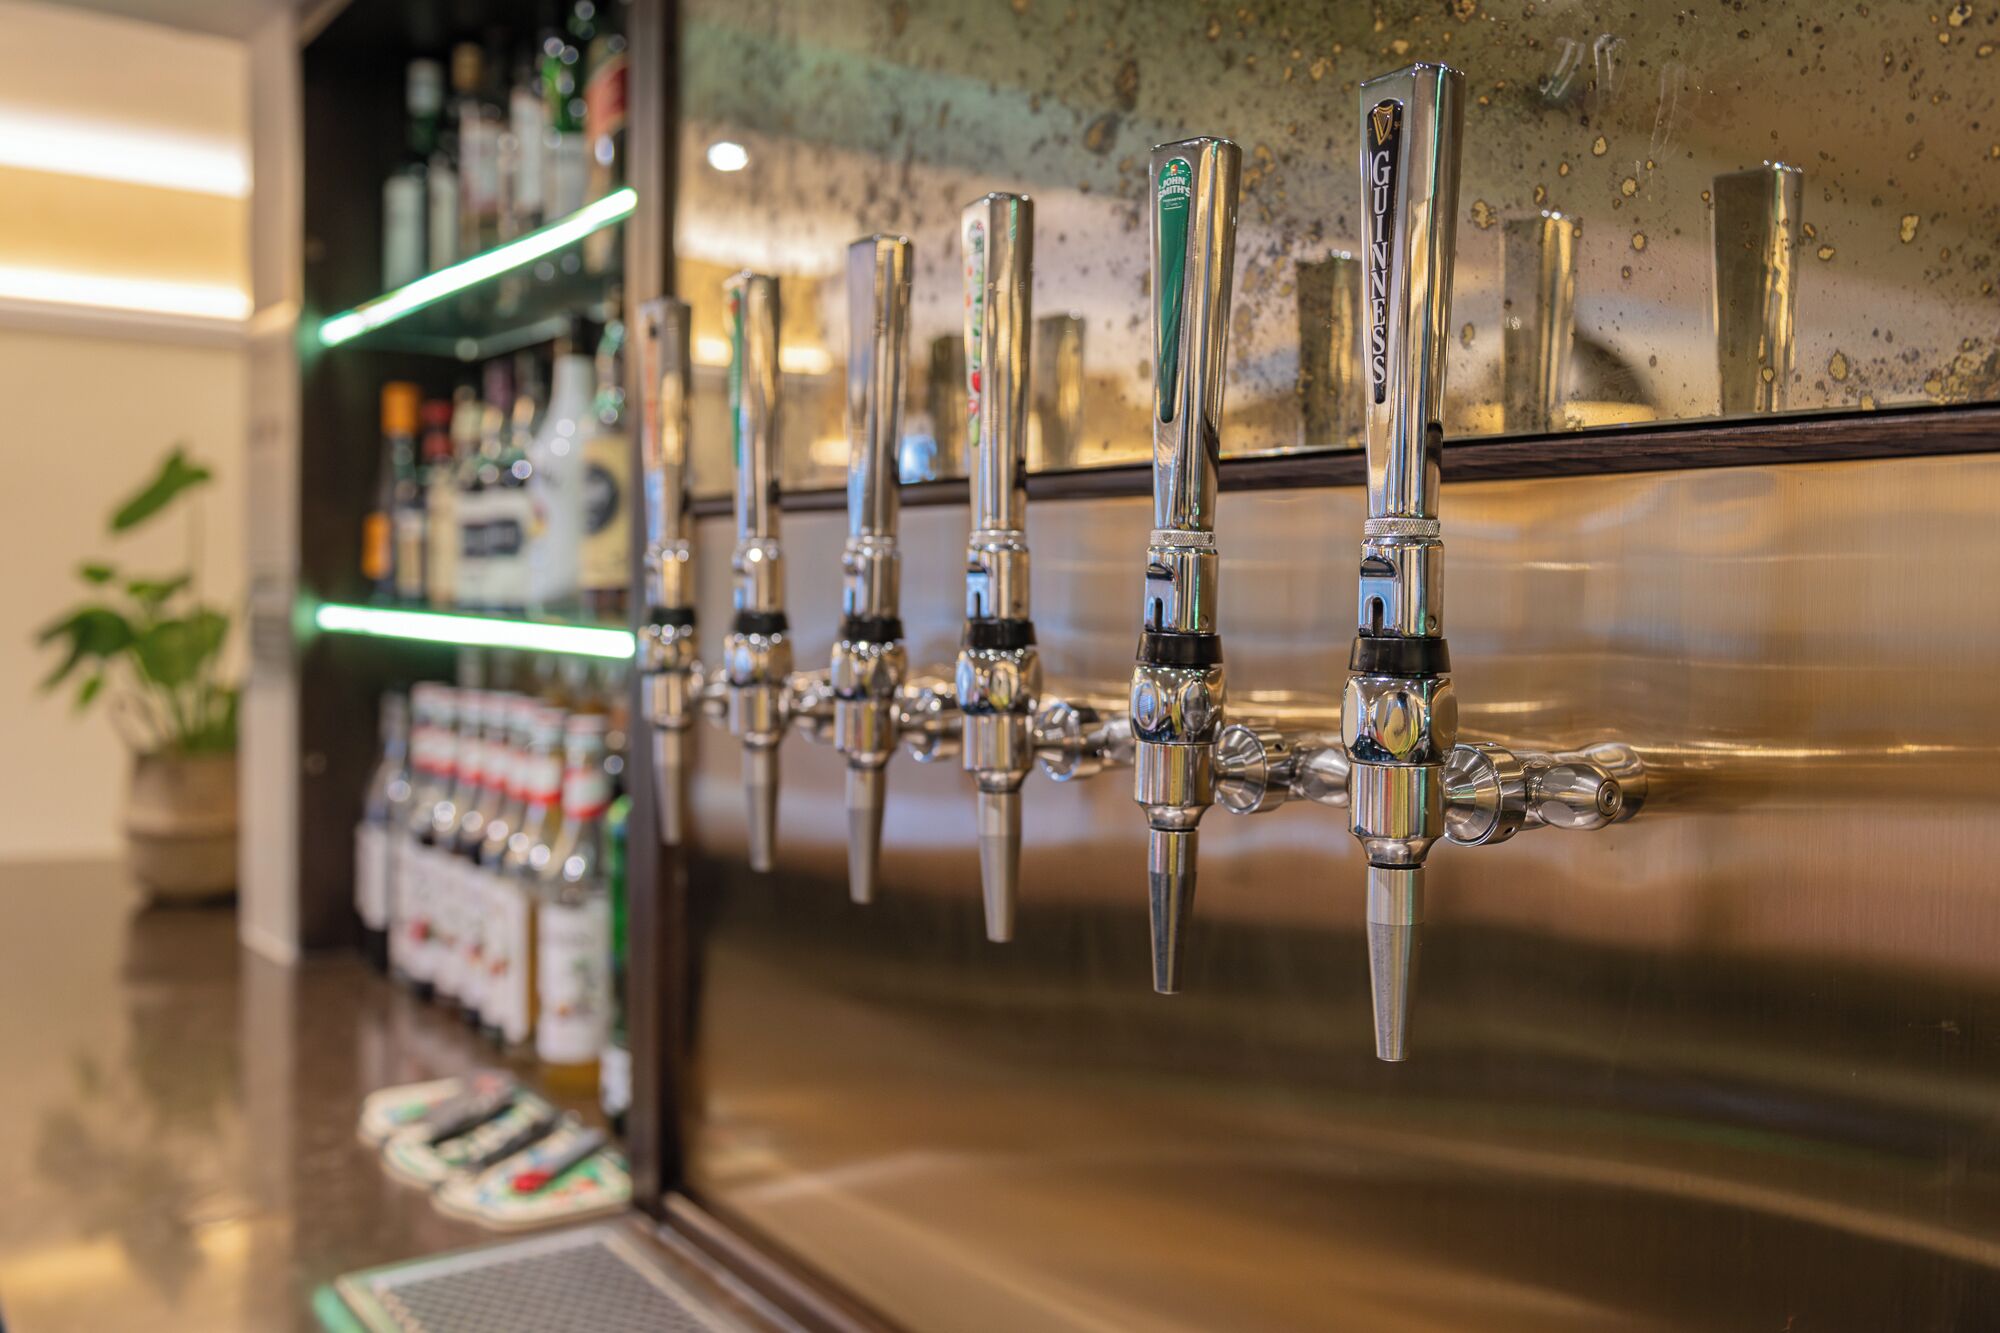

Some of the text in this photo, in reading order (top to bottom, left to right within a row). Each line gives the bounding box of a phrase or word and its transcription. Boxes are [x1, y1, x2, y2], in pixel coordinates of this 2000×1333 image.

[1161, 176, 1185, 189] JOHN
[1158, 185, 1190, 198] SMITH'S
[1370, 149, 1392, 384] GUINNESS
